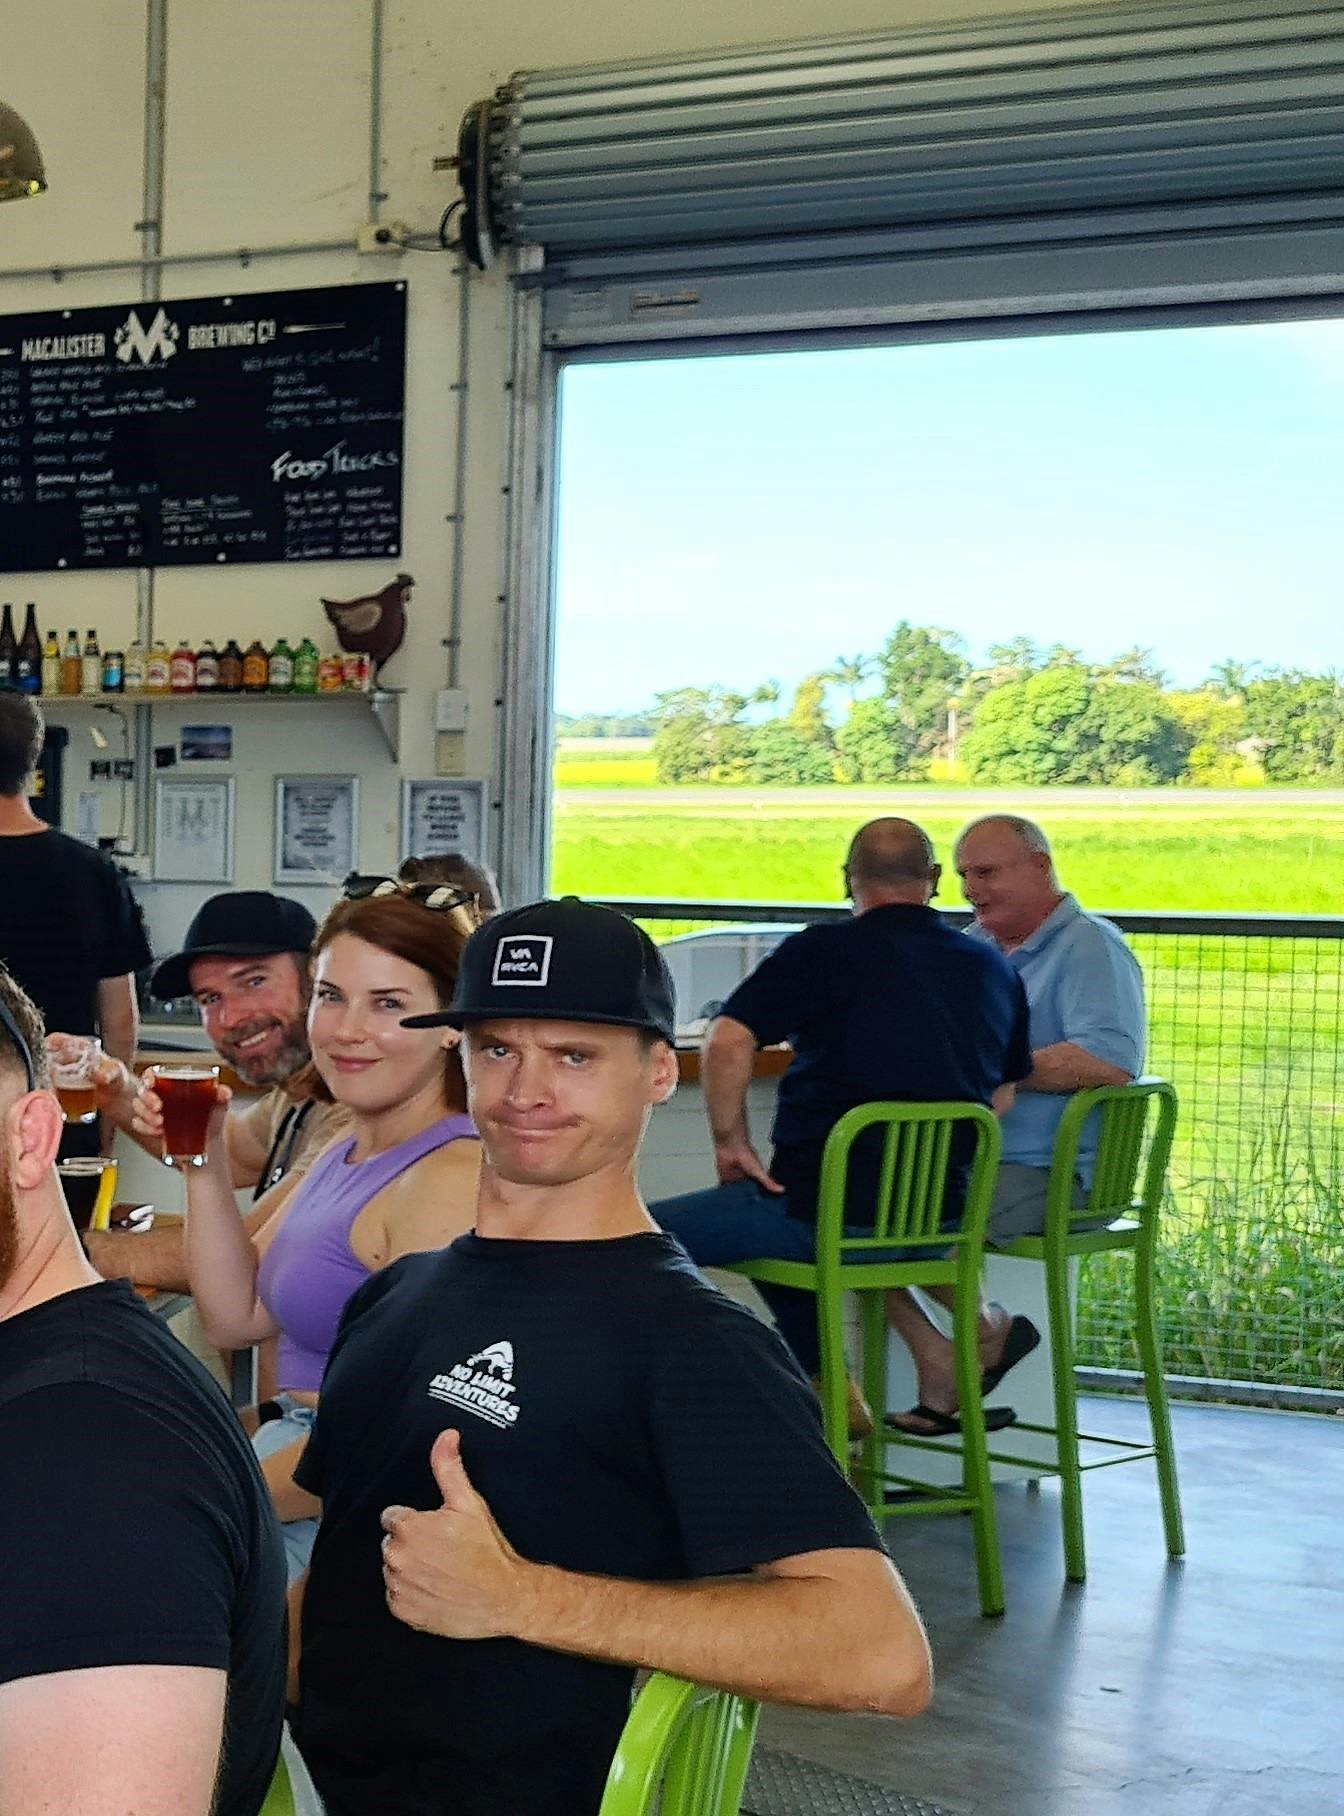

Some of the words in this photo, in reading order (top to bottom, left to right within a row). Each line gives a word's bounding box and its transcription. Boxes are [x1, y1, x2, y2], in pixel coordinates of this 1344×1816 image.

[21, 333, 105, 361] MACALISTER
[188, 321, 255, 349] BREWING
[509, 948, 532, 960] VA
[500, 962, 539, 972] RVCA
[448, 1364, 472, 1381] NO
[470, 1371, 516, 1398] LIMIT
[428, 1374, 521, 1422] ADVENTURES
